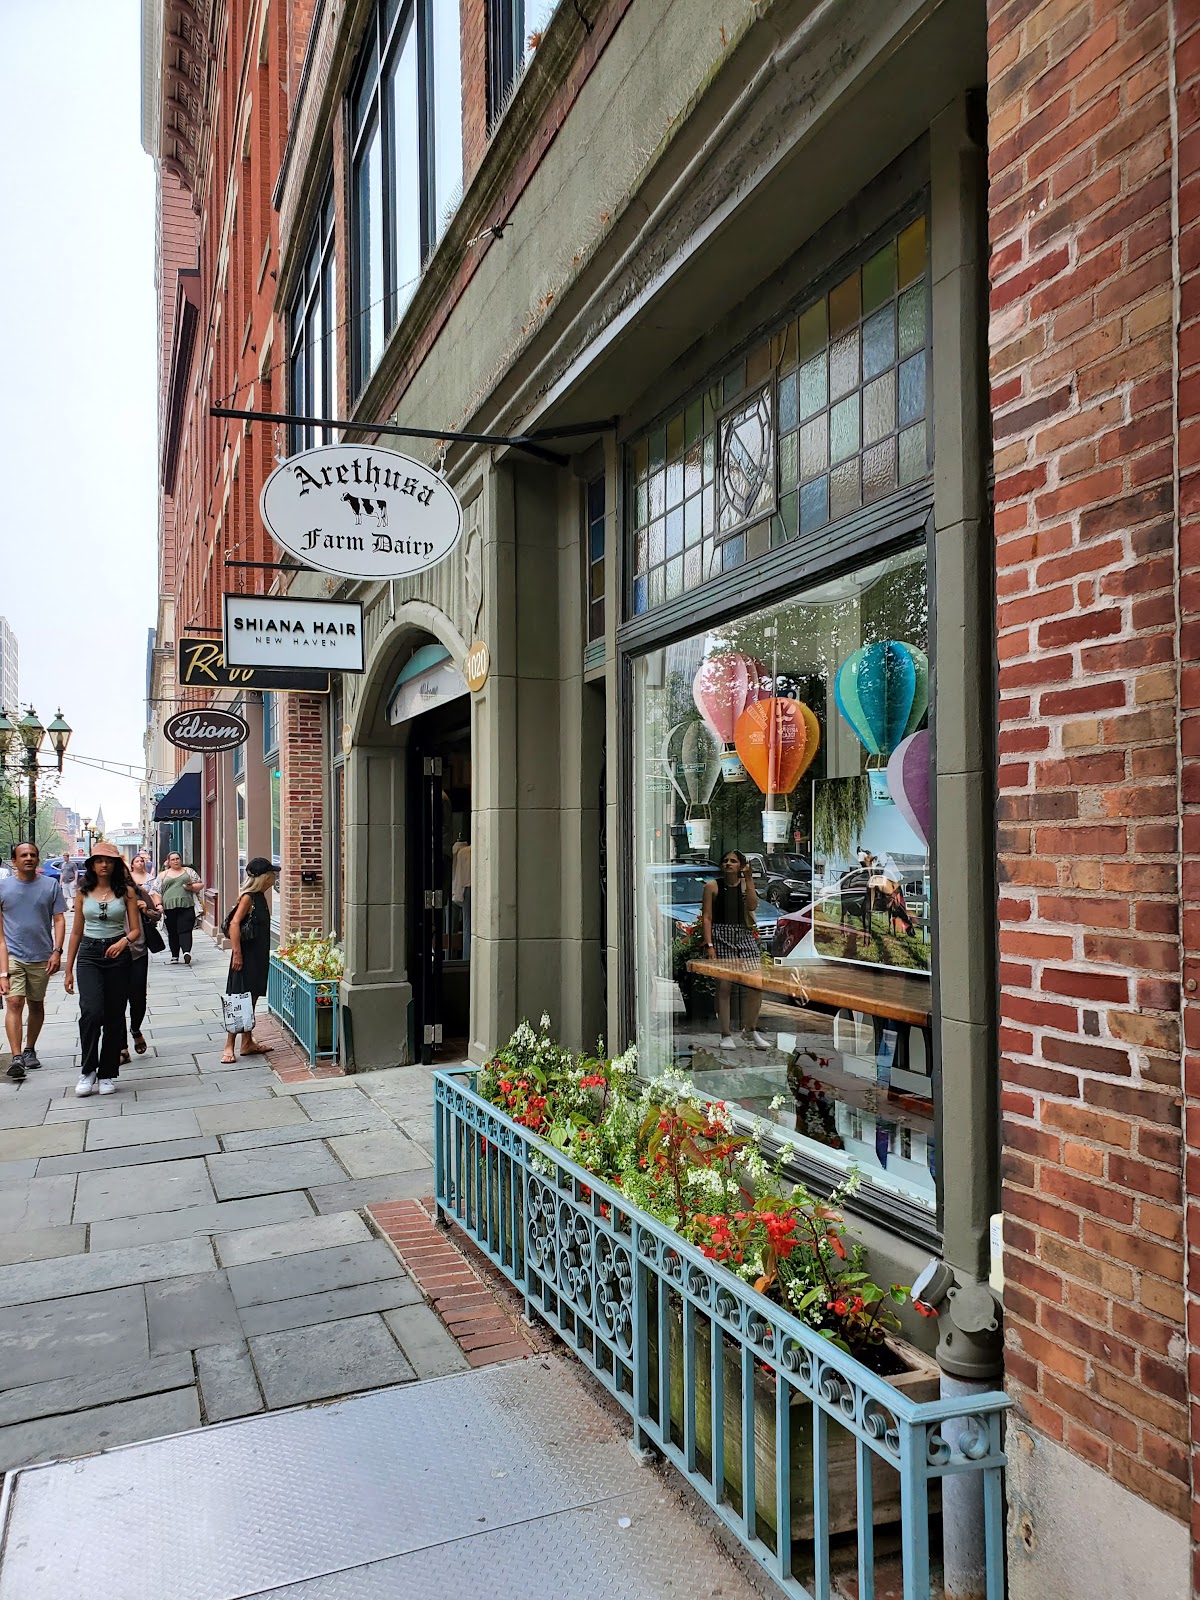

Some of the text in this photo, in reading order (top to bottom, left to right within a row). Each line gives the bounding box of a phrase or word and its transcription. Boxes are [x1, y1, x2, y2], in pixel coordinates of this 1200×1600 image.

[293, 456, 436, 506] Arethusa
[300, 528, 434, 560] Farm Dairy
[234, 617, 356, 636] SHIANA HAIR
[293, 638, 336, 647] HAVEN
[467, 649, 486, 682] 1020
[174, 715, 240, 739] idiom
